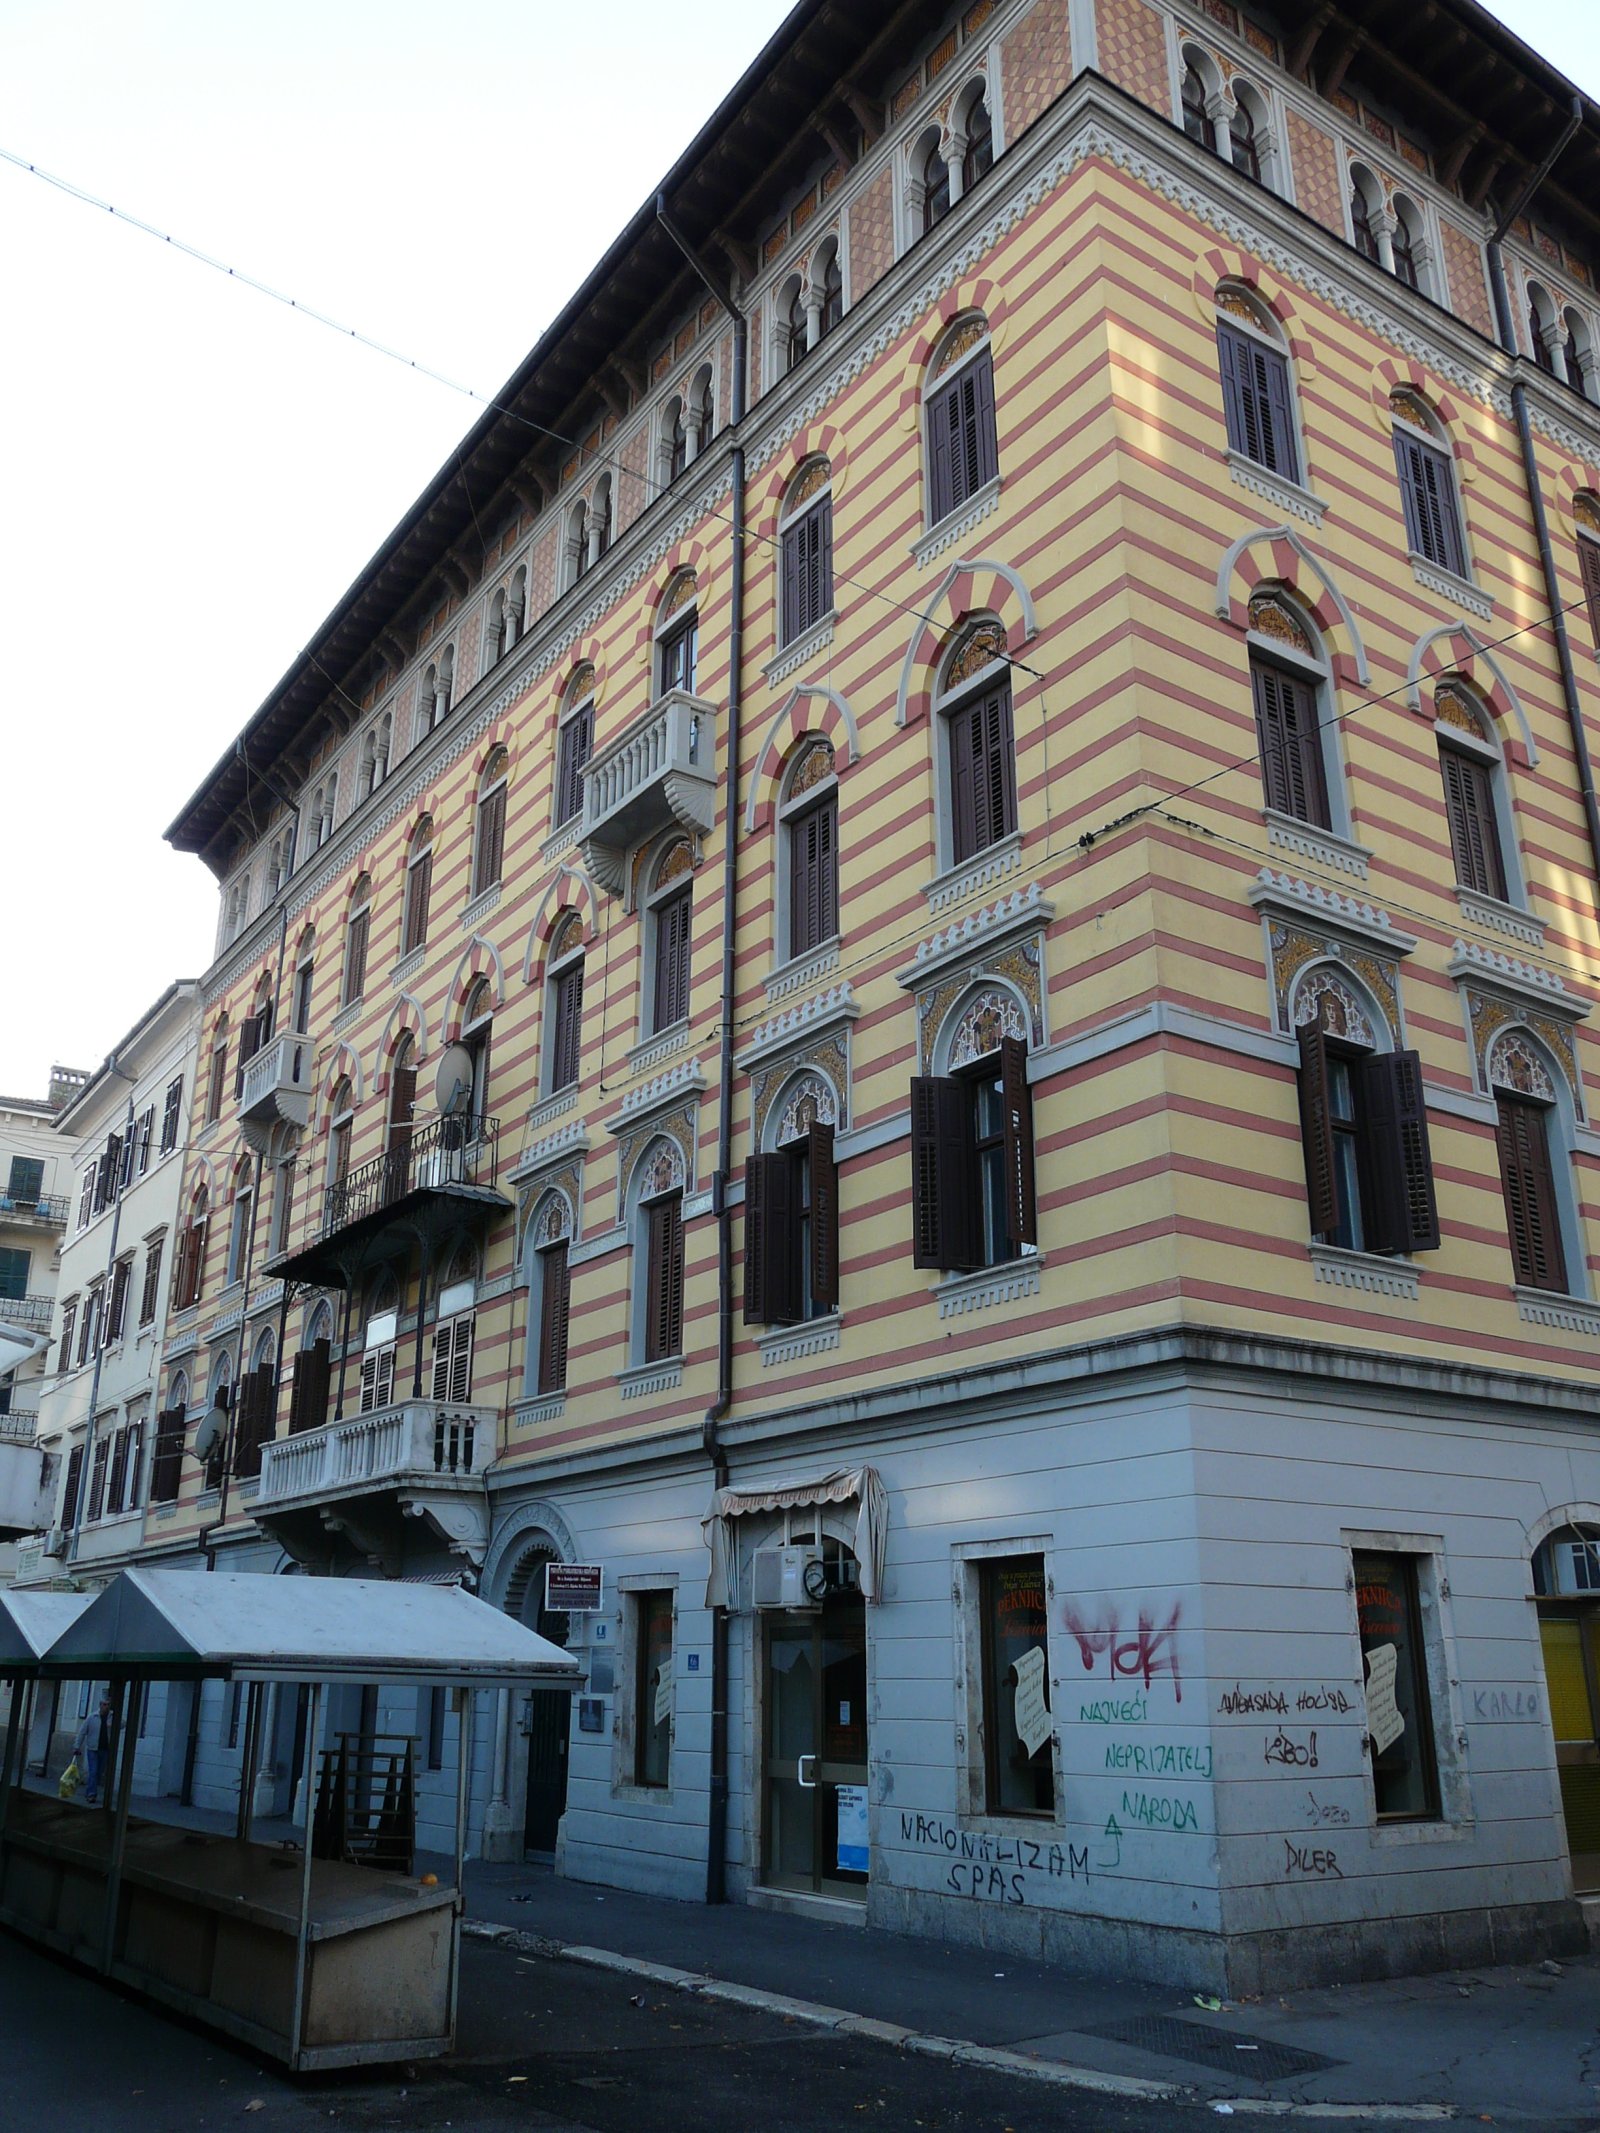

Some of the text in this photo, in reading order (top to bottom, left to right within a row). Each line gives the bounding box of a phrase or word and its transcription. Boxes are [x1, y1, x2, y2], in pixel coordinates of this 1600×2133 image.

[1080, 1689, 1147, 1724] NAJVEĆI
[1473, 1690, 1537, 1717] KARLO
[1105, 1743, 1212, 1778] NEPRIJATELJ
[1122, 1790, 1198, 1830] NARODA
[1284, 1838, 1344, 1879] DILER
[947, 1863, 1025, 1905] SPAS
